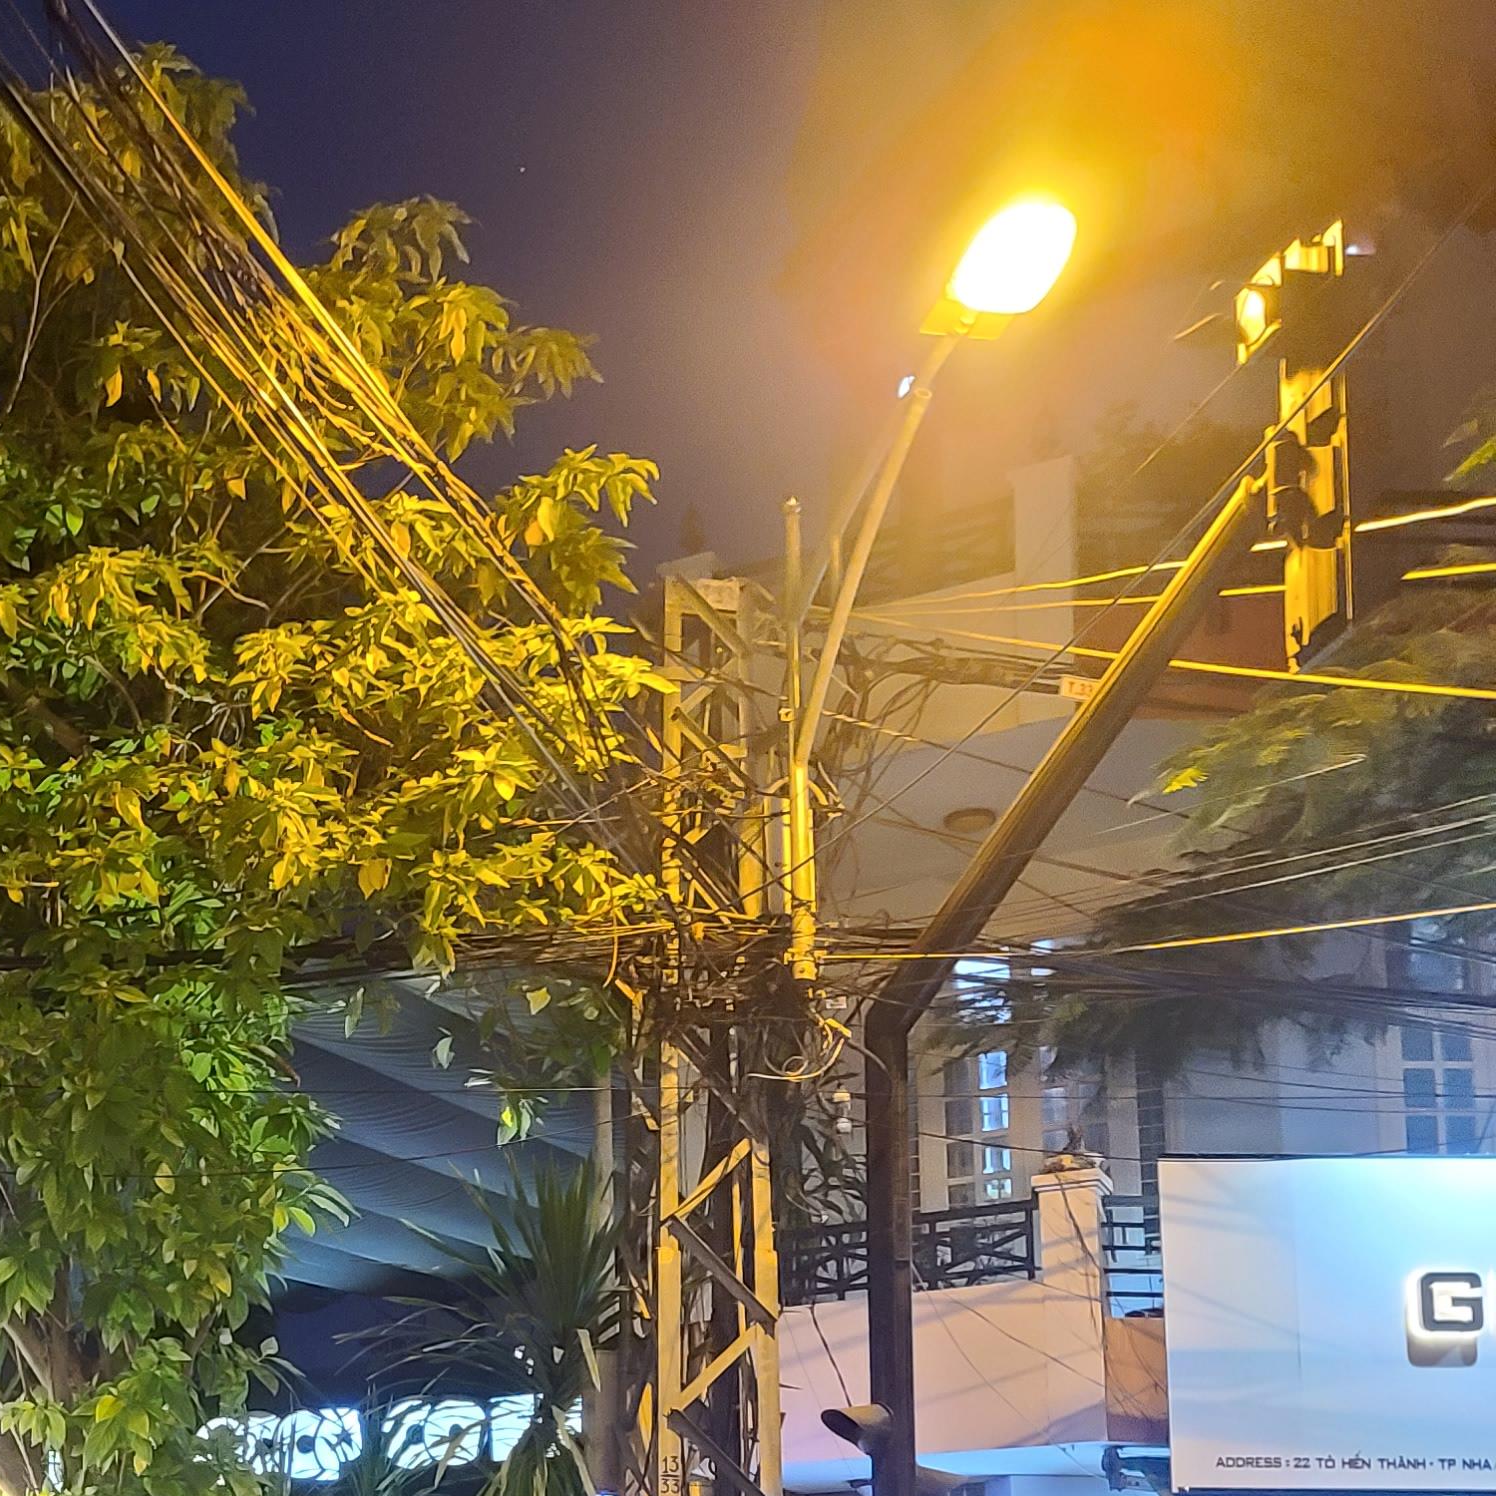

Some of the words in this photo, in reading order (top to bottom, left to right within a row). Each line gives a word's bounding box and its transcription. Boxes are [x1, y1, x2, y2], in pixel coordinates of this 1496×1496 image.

[1420, 1272, 1483, 1331] G
[662, 1455, 679, 1474] 13
[1293, 1457, 1311, 1469] 22
[1378, 1455, 1427, 1470] THÀNH
[1438, 1458, 1457, 1471] TP
[1463, 1458, 1492, 1471] NHA
[660, 1478, 680, 1494] 33
